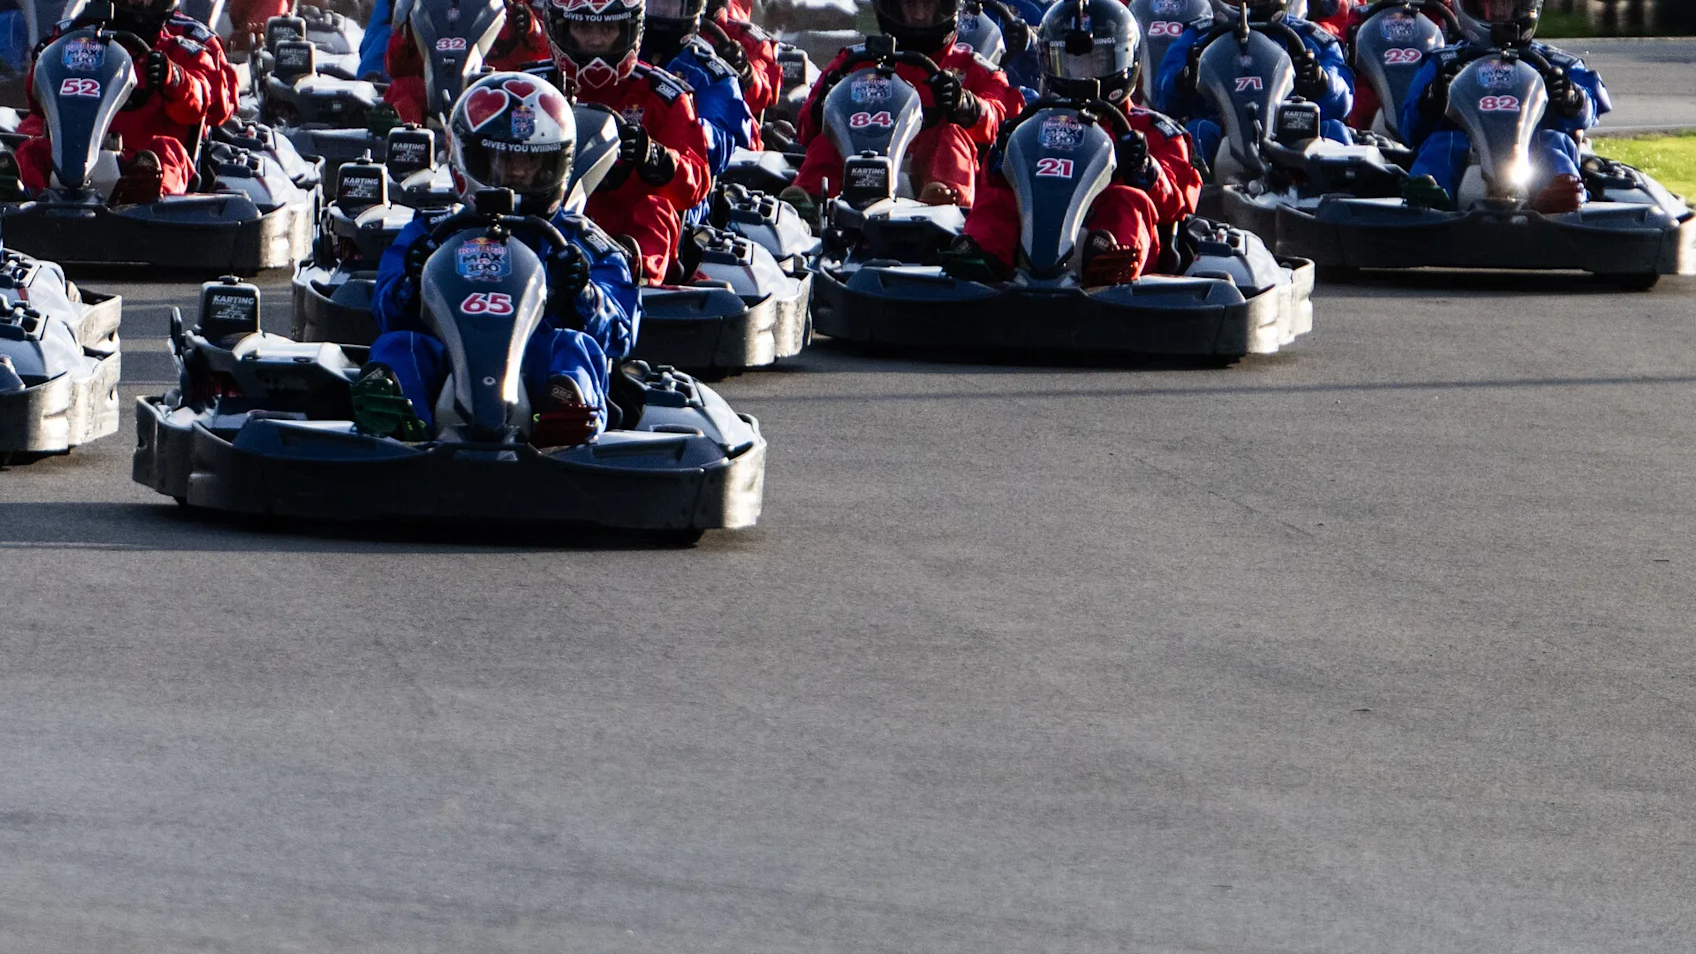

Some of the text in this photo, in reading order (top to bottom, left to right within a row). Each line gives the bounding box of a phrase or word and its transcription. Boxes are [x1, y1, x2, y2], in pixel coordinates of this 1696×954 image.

[563, 11, 632, 22] GIVES YOU WIIINGS
[435, 37, 467, 51] 32
[1384, 48, 1422, 66] 29
[59, 78, 101, 98] 52
[657, 83, 677, 98] OMP
[1235, 76, 1263, 92] 71
[1479, 95, 1520, 112] 82
[849, 111, 893, 128] 84
[1284, 110, 1315, 118] KARTING
[392, 142, 426, 150] KARTING
[481, 138, 561, 153] GIVES YOU WIIINGS
[852, 167, 886, 175] KARTING
[1035, 158, 1074, 178] 21
[343, 177, 379, 186] KARTING
[462, 252, 504, 263] MAX
[468, 263, 500, 272] 100
[213, 294, 255, 305] KARTING
[460, 292, 514, 315] 65
